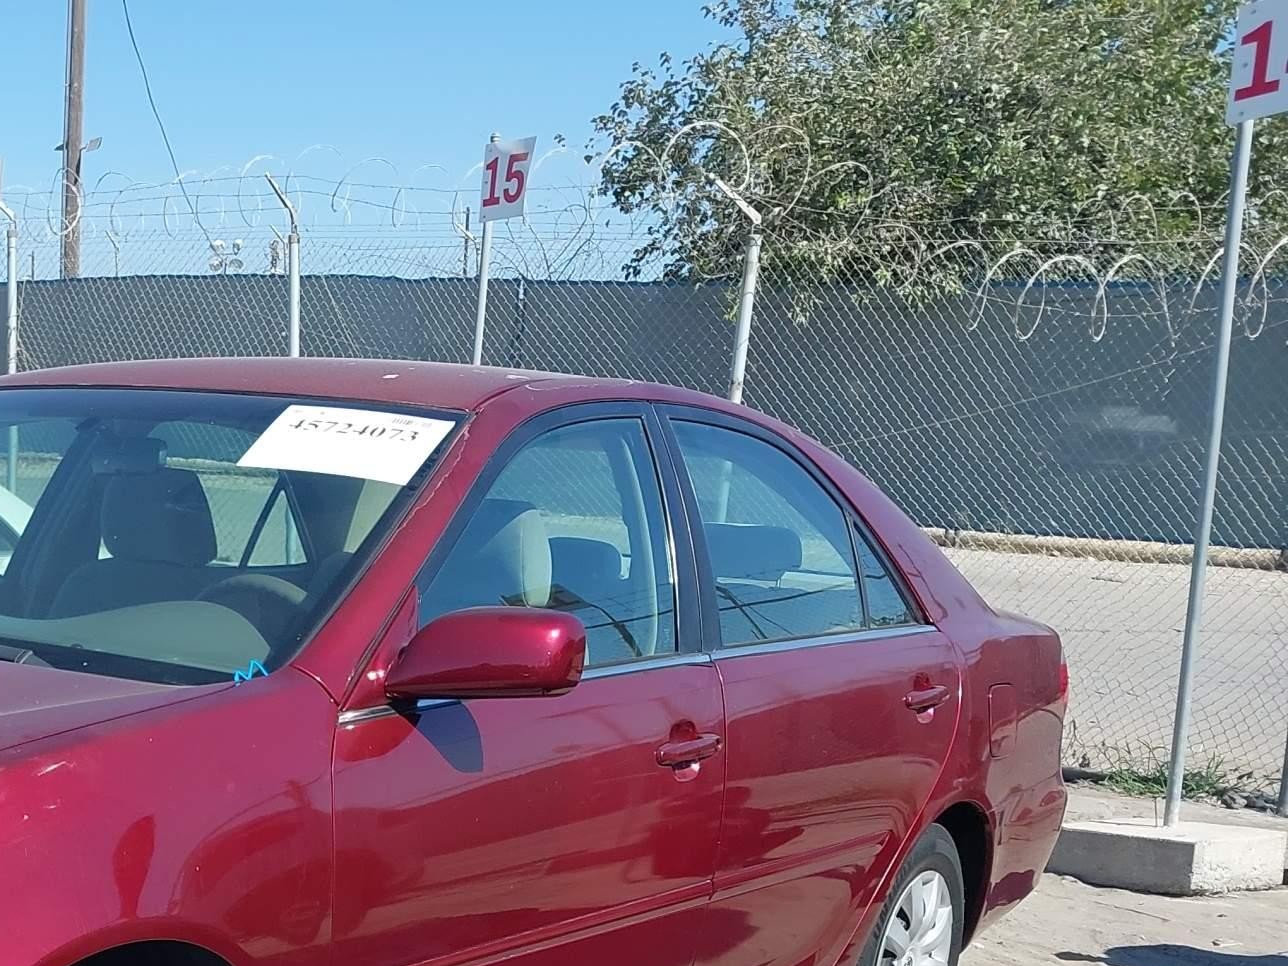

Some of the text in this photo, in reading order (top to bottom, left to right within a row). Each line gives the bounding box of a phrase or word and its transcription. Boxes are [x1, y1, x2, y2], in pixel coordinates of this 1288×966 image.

[1234, 20, 1288, 102] 1
[482, 152, 529, 207] 15
[289, 418, 419, 442] 45724073
